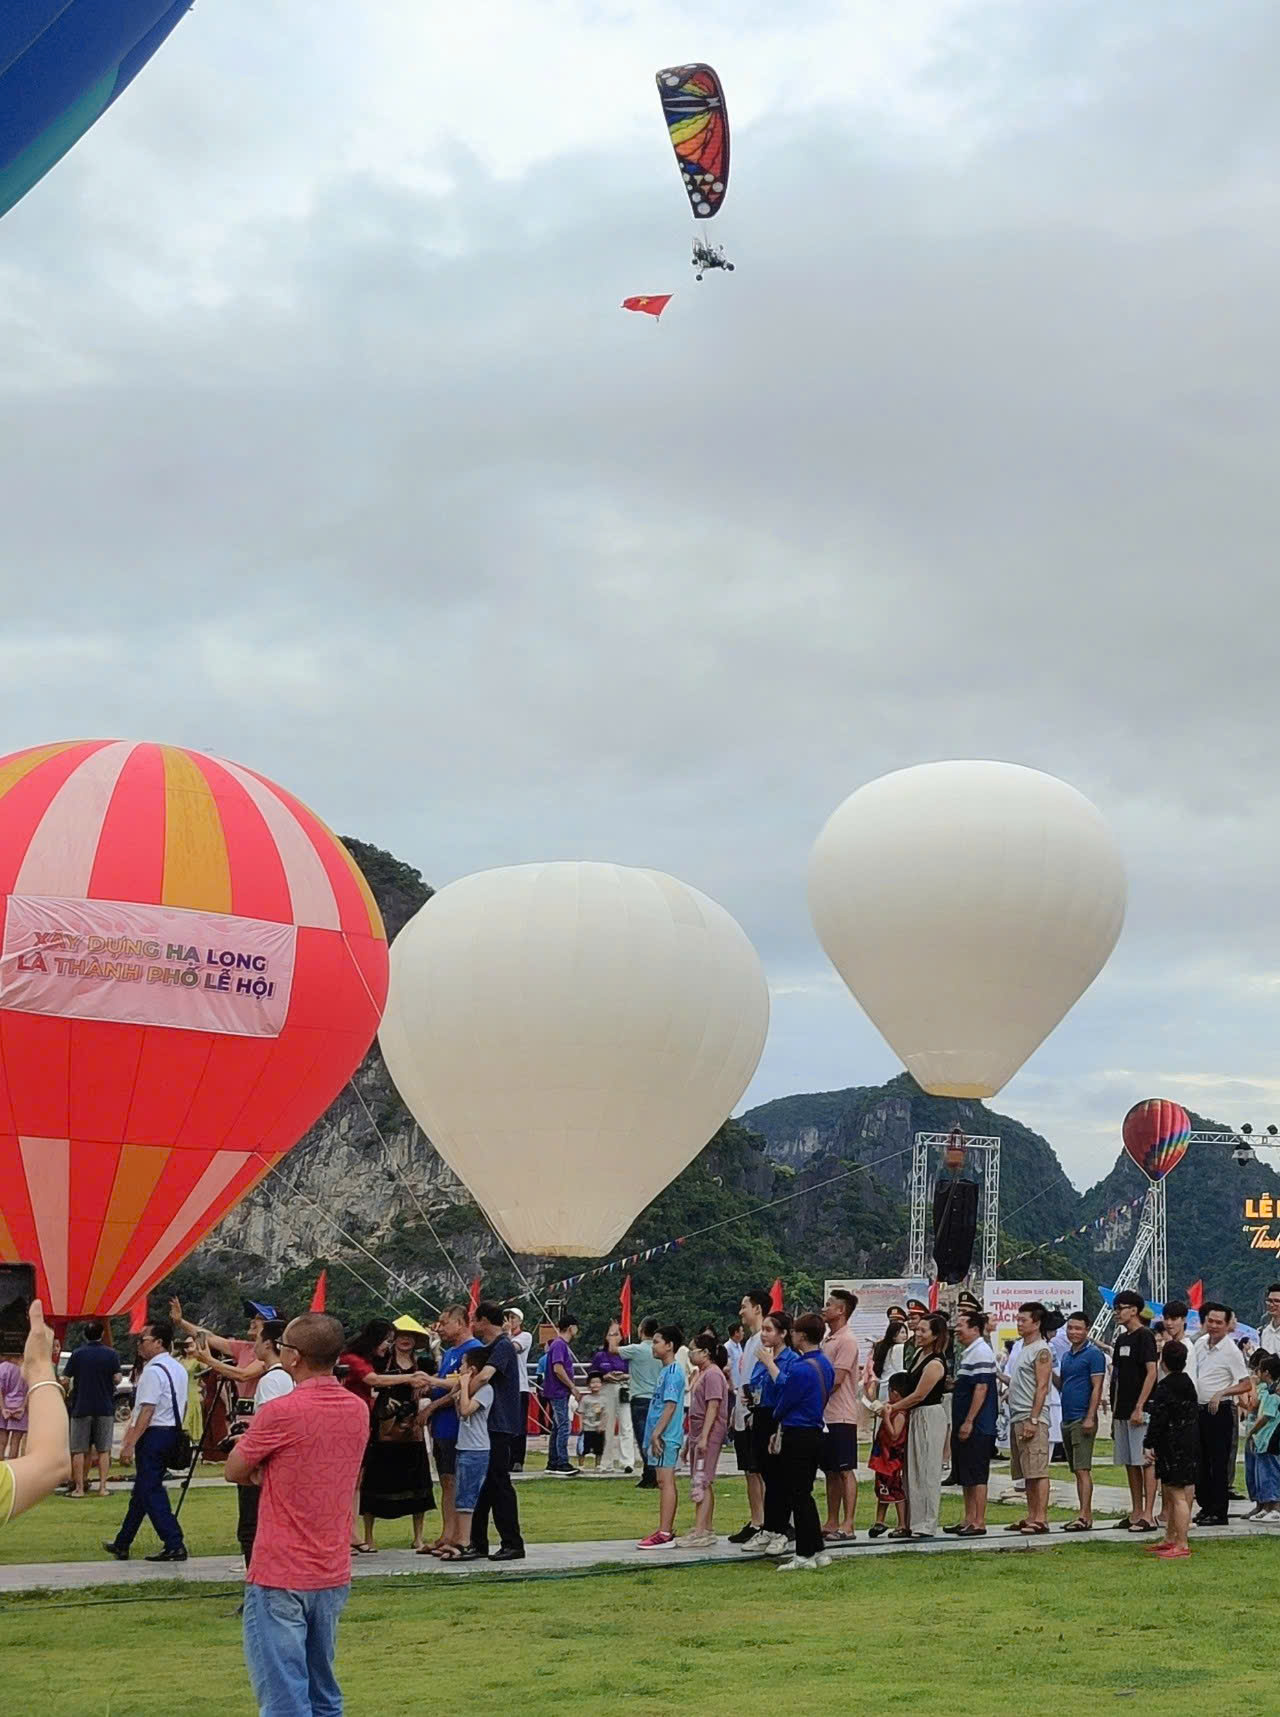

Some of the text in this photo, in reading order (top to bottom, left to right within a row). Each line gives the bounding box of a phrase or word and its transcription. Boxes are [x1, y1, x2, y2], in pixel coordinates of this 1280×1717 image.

[88, 935, 160, 960] DỰNG
[166, 943, 201, 967] HẠ
[207, 949, 268, 972] LONG
[16, 951, 275, 1000] LÀ THÀNH PHỐ LỄ HỘI
[1245, 1192, 1273, 1218] LỄ
